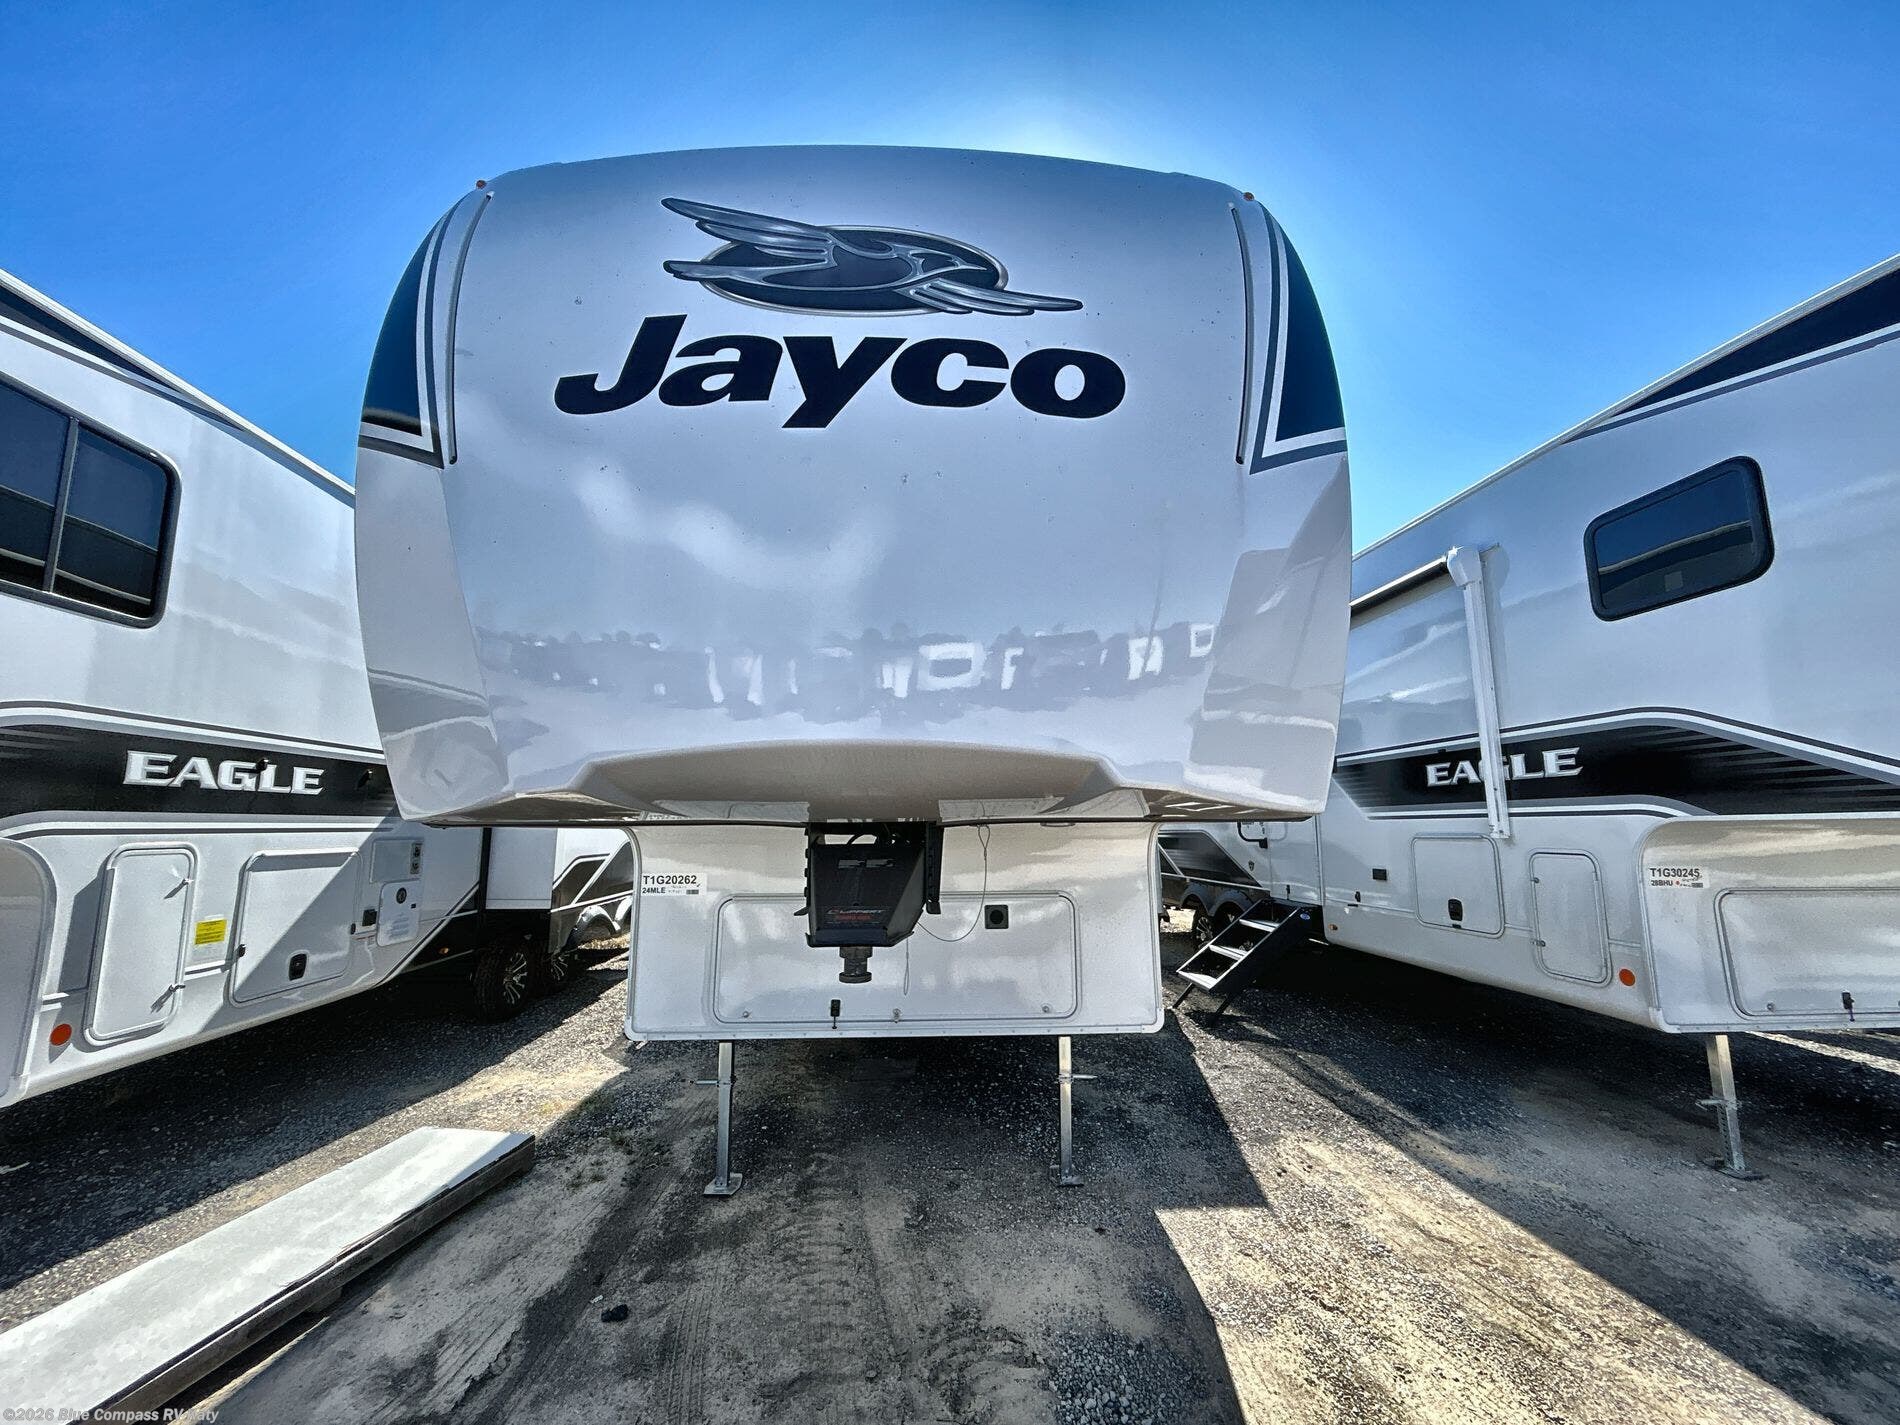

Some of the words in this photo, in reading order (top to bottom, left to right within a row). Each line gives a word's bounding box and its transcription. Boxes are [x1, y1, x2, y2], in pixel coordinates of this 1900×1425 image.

[554, 314, 1125, 428] Jayco
[123, 750, 326, 795] EAGLE
[643, 875, 697, 885] T1G20262
[1650, 868, 1700, 878] T1G30245
